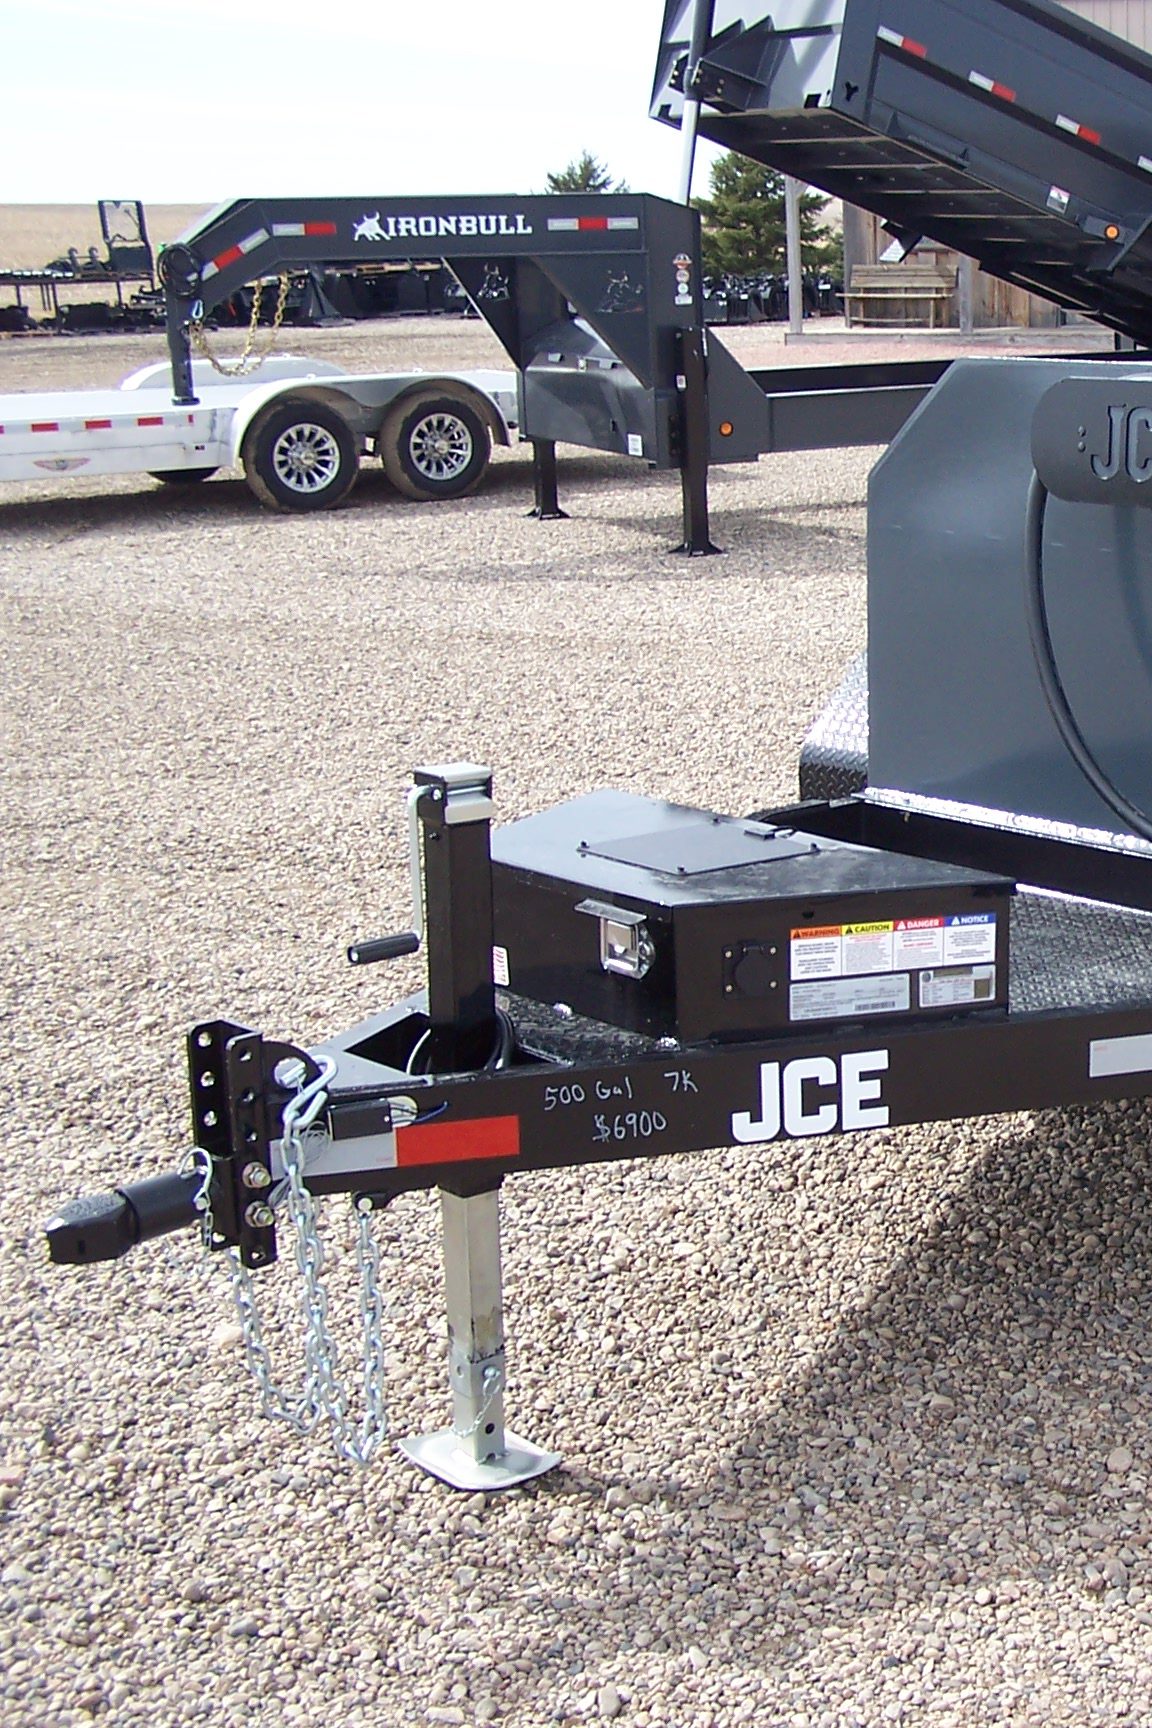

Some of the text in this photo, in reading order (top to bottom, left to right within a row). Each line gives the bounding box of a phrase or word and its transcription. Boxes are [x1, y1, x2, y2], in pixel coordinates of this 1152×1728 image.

[388, 214, 533, 237] IRONBULL
[907, 919, 940, 929] DANGER
[961, 915, 988, 924] NOTICE
[801, 928, 839, 938] WARNING
[855, 924, 890, 933] CAUTION
[544, 1084, 585, 1111] 500
[732, 1049, 889, 1143] JCE
[592, 1111, 667, 1143] $6900
